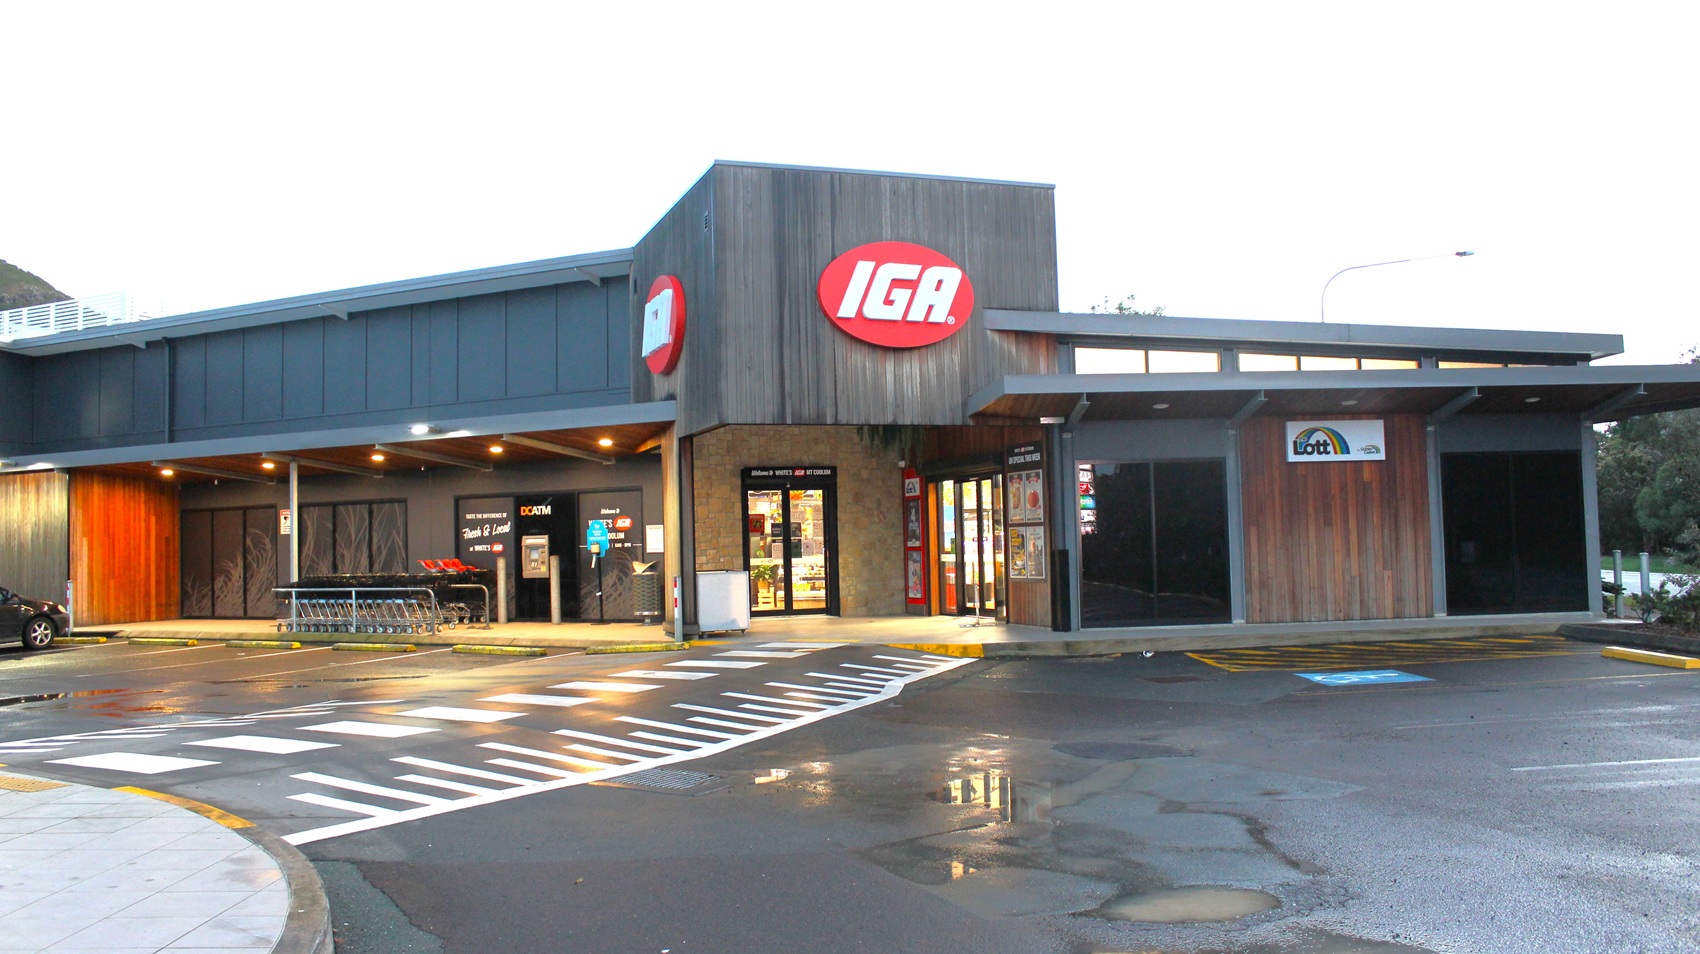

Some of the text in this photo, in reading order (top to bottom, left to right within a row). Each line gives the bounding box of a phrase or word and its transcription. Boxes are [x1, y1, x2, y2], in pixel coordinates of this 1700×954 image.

[1293, 439, 1330, 456] Lott
[1013, 455, 1024, 464] SPECIAL
[616, 518, 631, 528] IGA
[462, 526, 481, 540] Fresh
[492, 521, 511, 536] Local
